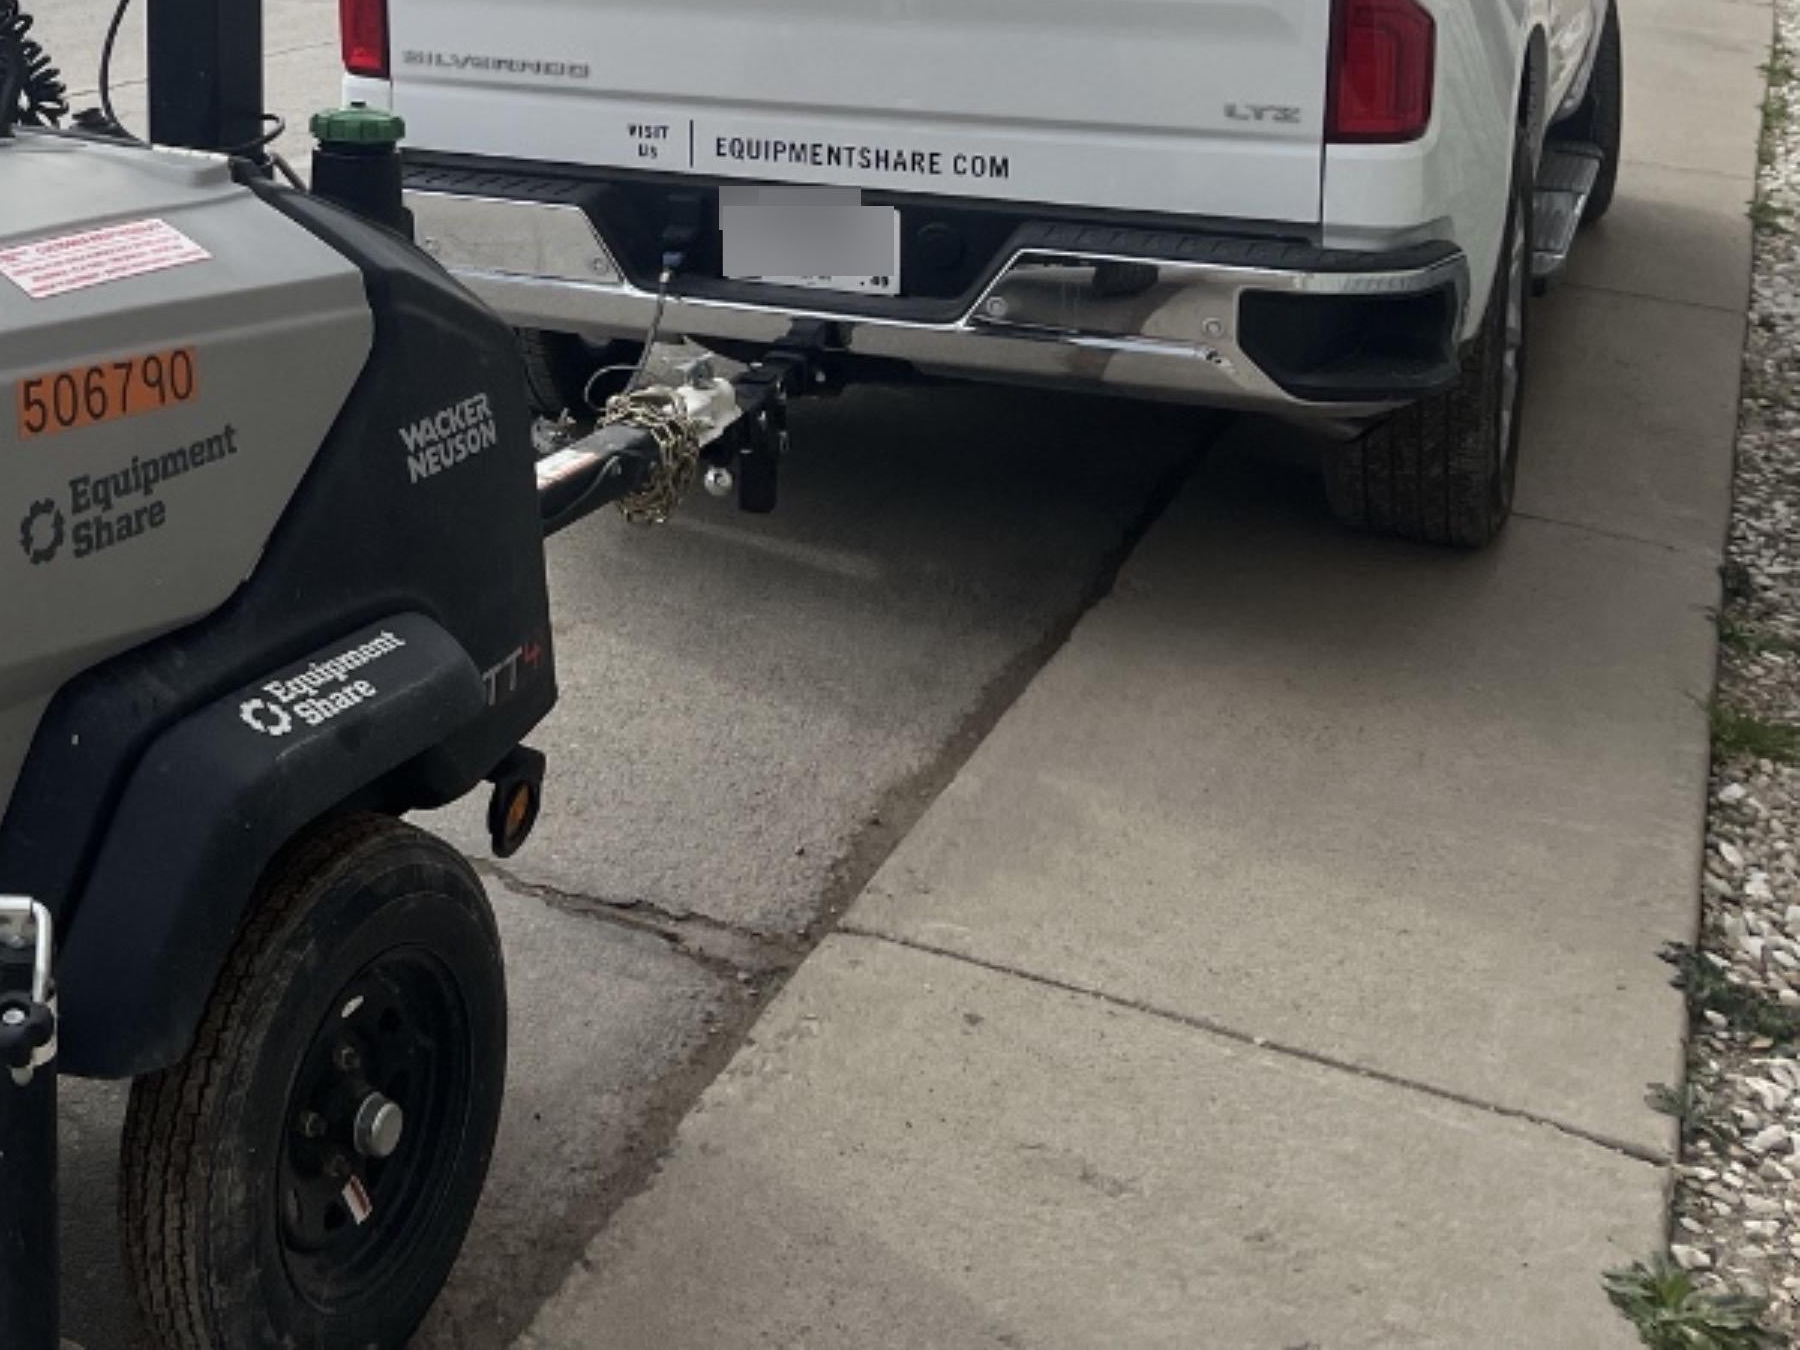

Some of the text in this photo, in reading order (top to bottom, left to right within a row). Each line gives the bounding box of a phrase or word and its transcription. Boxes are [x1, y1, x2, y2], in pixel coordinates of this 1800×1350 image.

[627, 123, 670, 140] VISIT
[638, 143, 659, 159] US
[23, 349, 193, 433] 506790
[398, 392, 493, 453] WACKER
[407, 419, 497, 485] NEUSON
[68, 422, 238, 515] Equipment
[72, 500, 166, 559] Share
[263, 630, 406, 702] Equipment
[294, 679, 377, 726] Share
